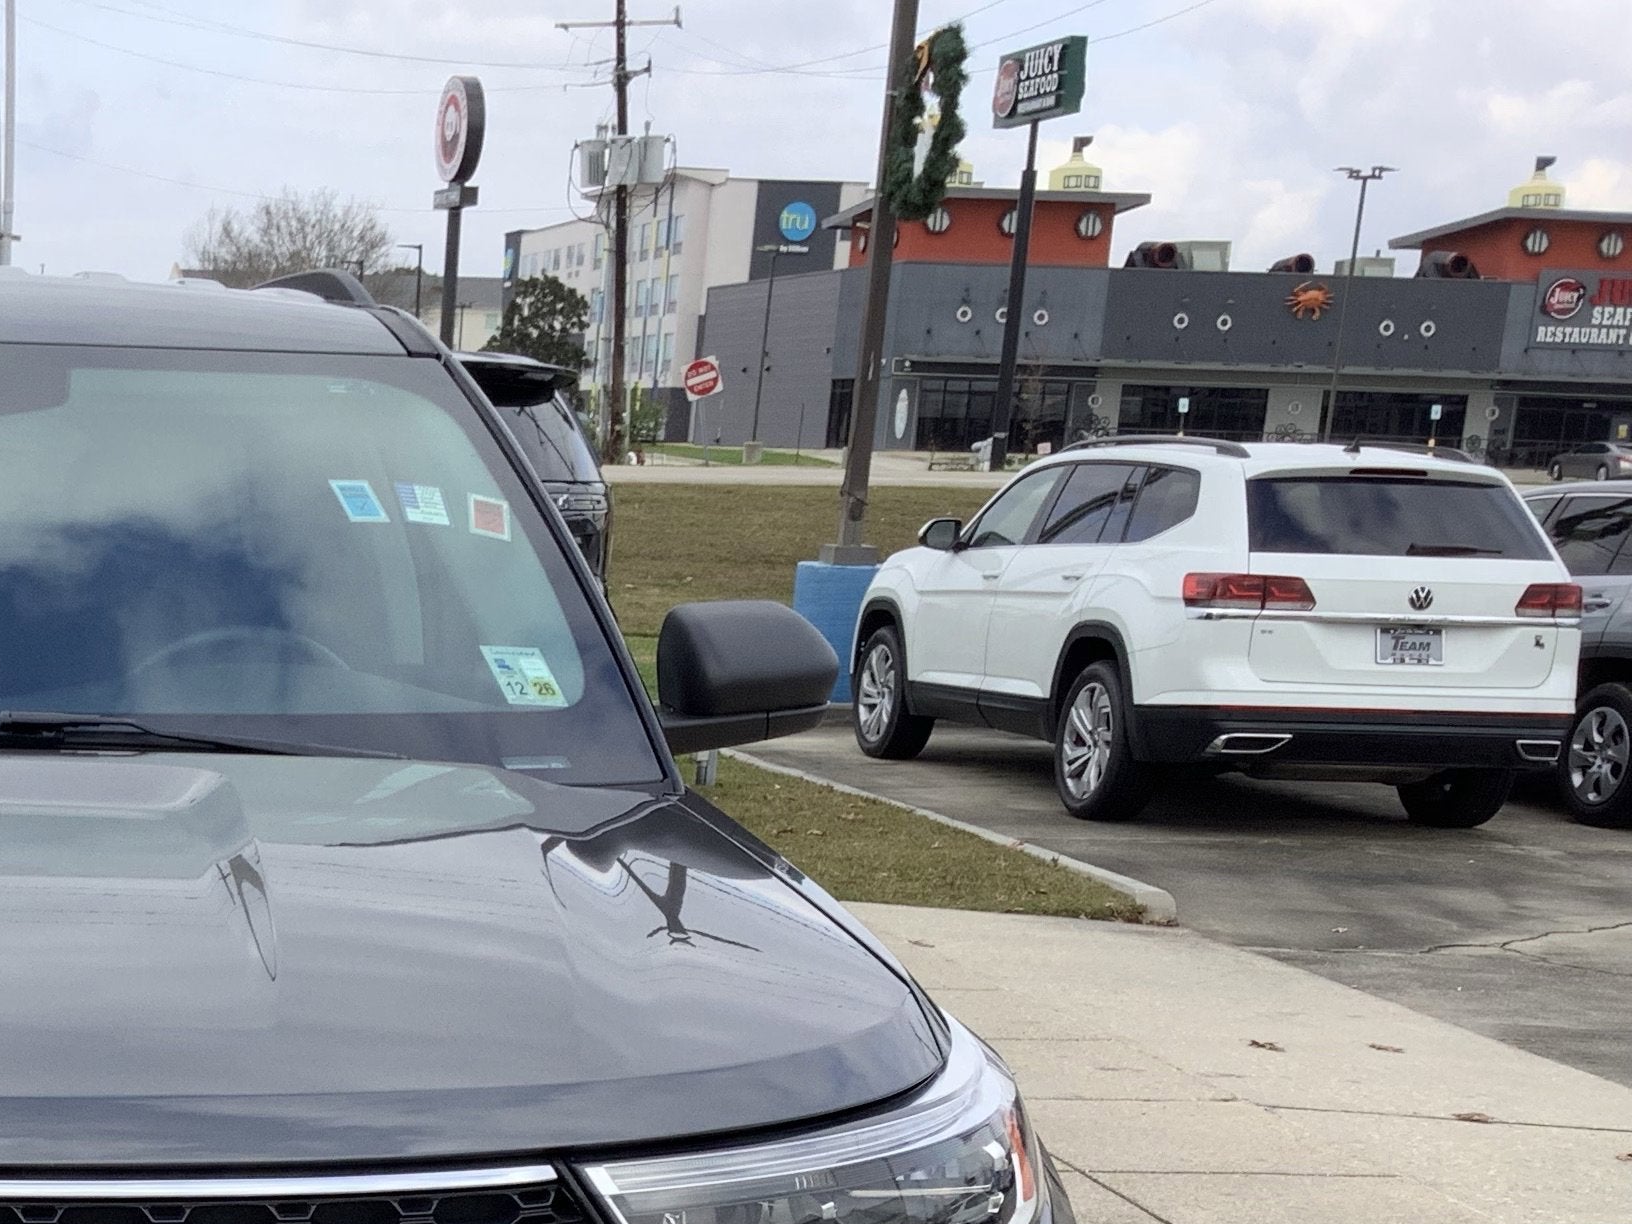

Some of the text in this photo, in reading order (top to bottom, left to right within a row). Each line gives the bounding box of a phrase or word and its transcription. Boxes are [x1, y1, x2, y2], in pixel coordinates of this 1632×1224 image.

[1019, 44, 1063, 80] JUICY
[1018, 73, 1059, 100] SEAFOOD
[782, 210, 809, 230] tru
[1536, 326, 1627, 345] RESTAURANT
[1390, 635, 1431, 653] TEAM
[506, 681, 556, 696] 12 26
